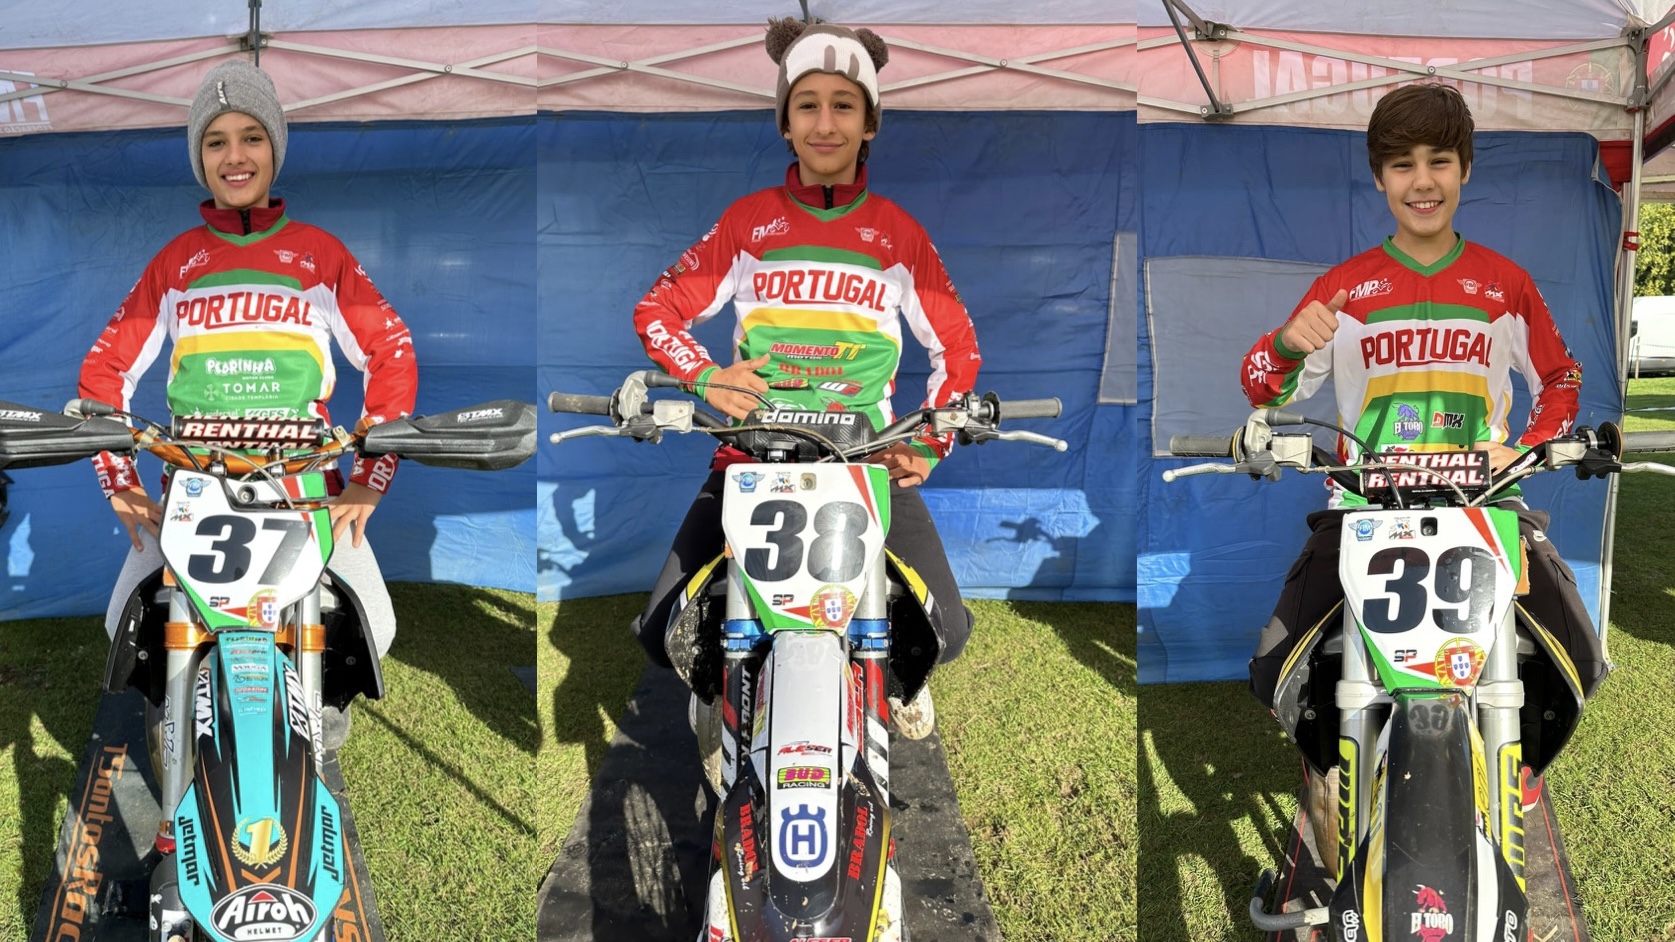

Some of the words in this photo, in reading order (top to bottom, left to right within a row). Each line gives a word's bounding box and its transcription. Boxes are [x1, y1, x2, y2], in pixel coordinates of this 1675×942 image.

[753, 269, 887, 312] PORTUGAL
[176, 291, 314, 330] PORTUGAL
[770, 342, 839, 357] MOMENTO
[1360, 327, 1493, 369] PORTUGAL
[778, 363, 845, 377] BRADOL
[222, 382, 280, 393] TOMAR
[761, 408, 856, 426] domino
[1432, 411, 1465, 429] DMX
[182, 422, 317, 439] RENTHAL
[1403, 420, 1424, 434] TORO
[1368, 470, 1485, 488] RENTHAL
[187, 514, 313, 585] 37
[744, 499, 869, 583] 38
[1362, 546, 1497, 634] 39
[209, 596, 231, 608] SP
[772, 594, 795, 606] SP
[1393, 649, 1418, 662] SP
[784, 767, 825, 781] BUD
[782, 781, 826, 789] RACING
[246, 819, 274, 862] 1
[847, 806, 868, 880] BRADOL
[218, 892, 309, 931] Airoh
[247, 926, 283, 936] HELMET
[1424, 913, 1454, 934] TORO
